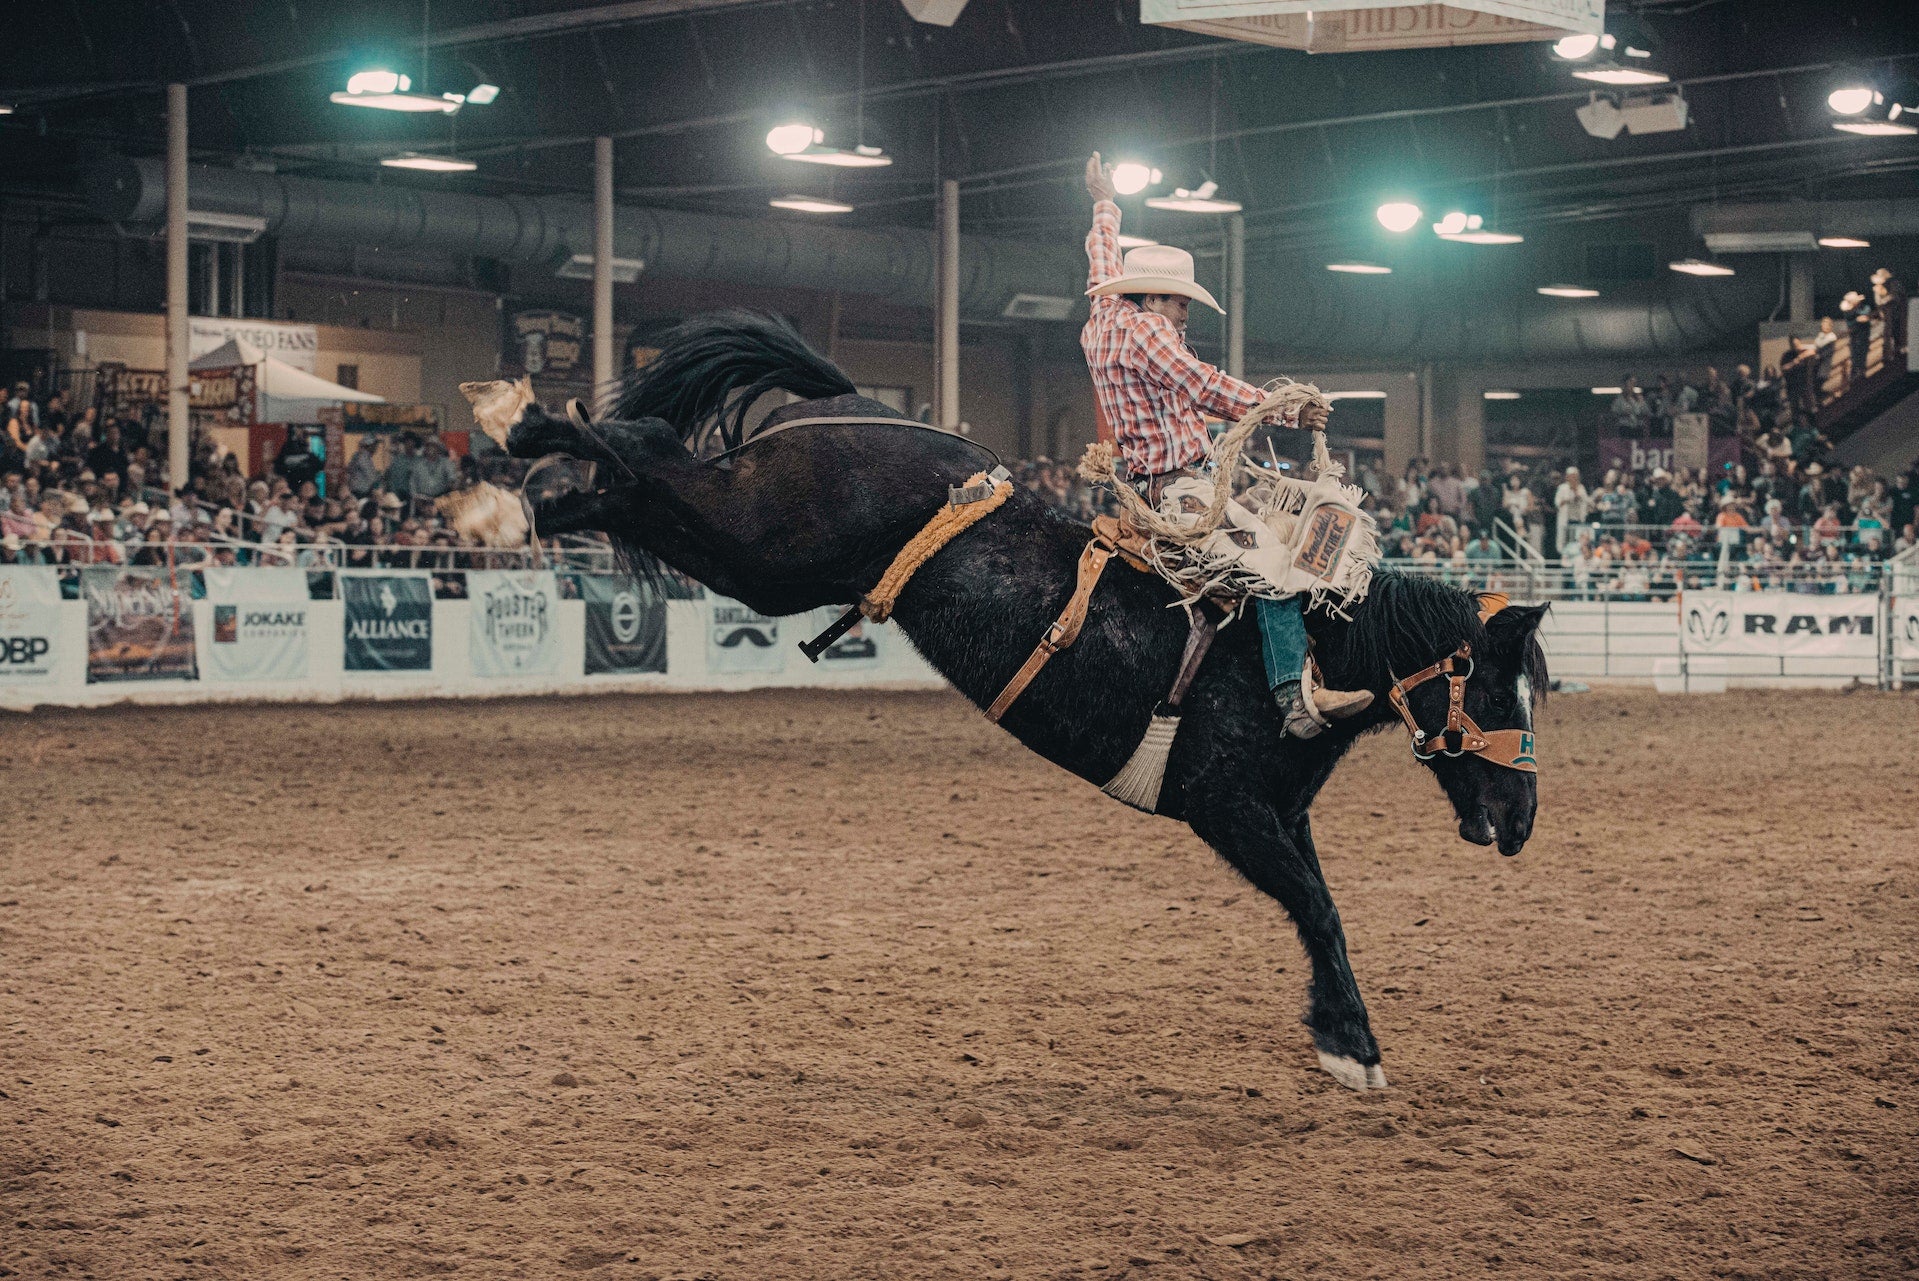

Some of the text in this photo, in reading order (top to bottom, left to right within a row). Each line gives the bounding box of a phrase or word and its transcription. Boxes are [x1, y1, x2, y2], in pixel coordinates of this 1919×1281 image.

[278, 330, 316, 350] FANS
[1317, 523, 1345, 570] LEATHER
[243, 611, 307, 627] JOKAKE
[347, 619, 429, 639] ALLIANCE
[1744, 614, 1874, 635] RAM
